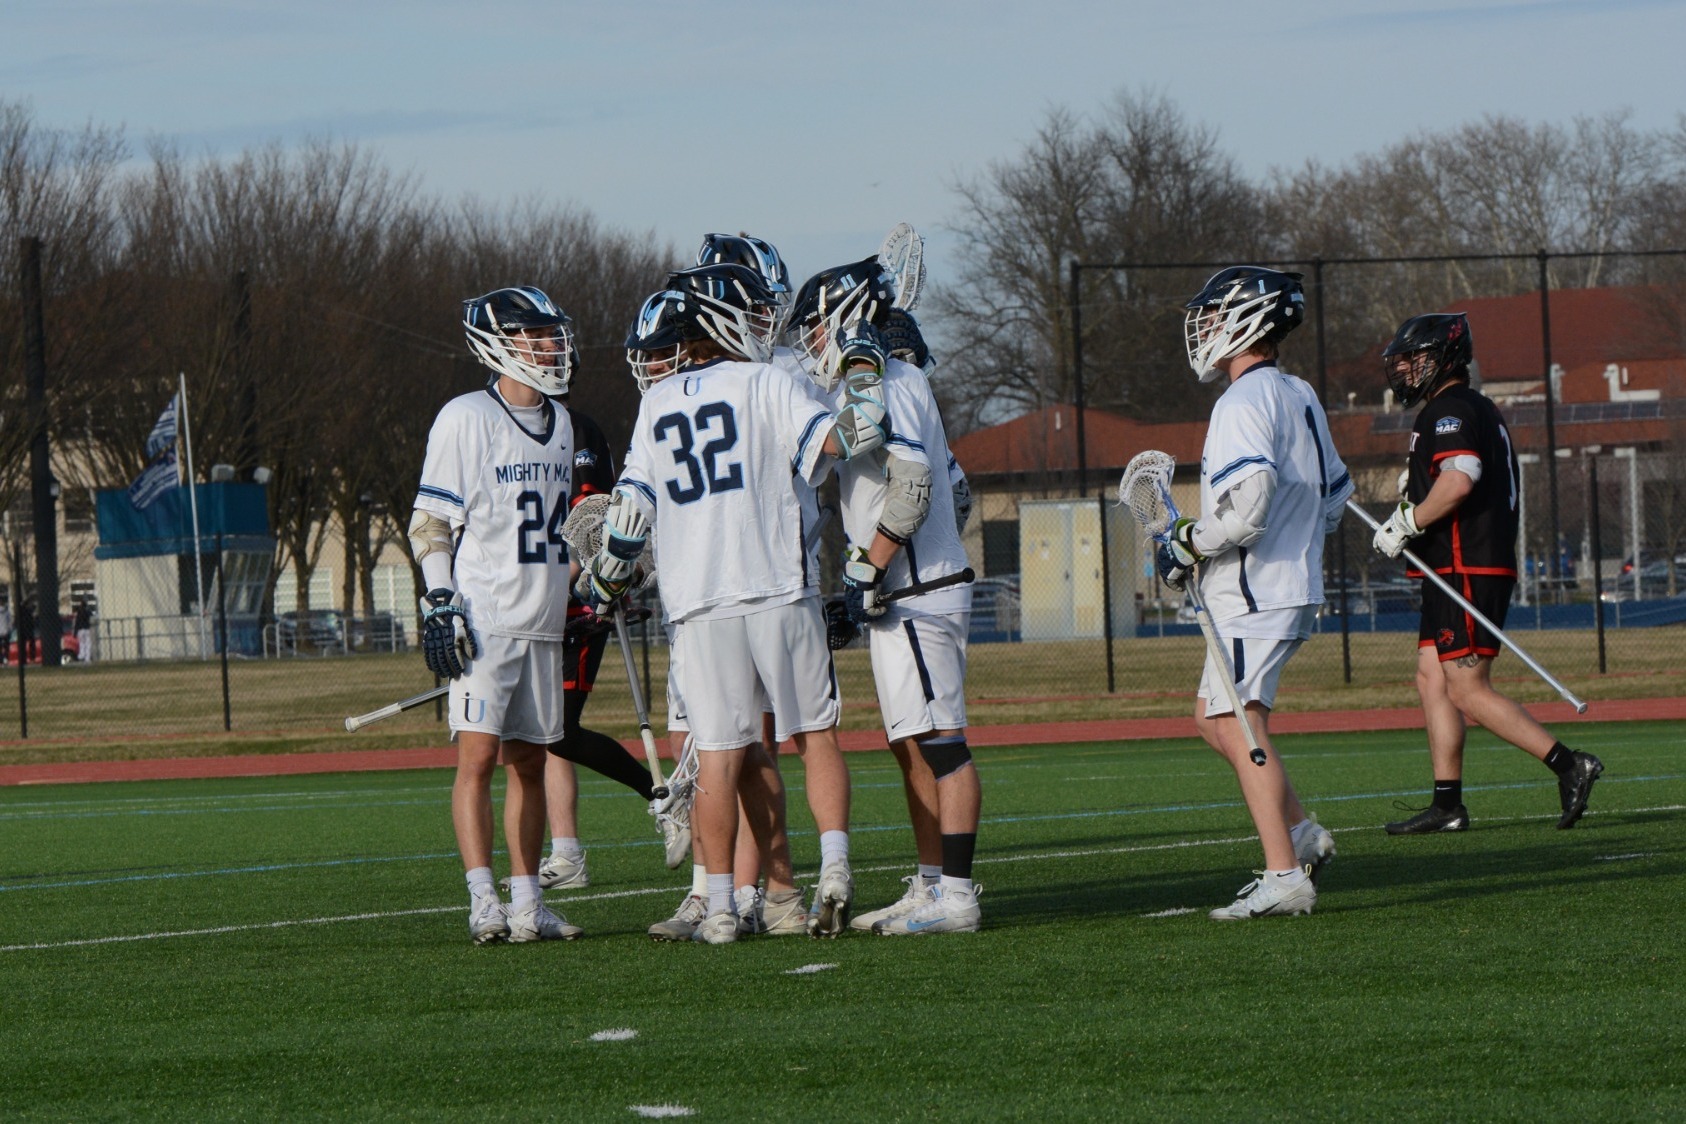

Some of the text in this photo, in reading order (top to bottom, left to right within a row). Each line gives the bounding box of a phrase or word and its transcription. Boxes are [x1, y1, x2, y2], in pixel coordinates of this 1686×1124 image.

[653, 400, 745, 506] 32
[1304, 405, 1327, 498] 1
[1435, 424, 1459, 434] MAC
[495, 462, 551, 484] MIGHTY
[516, 490, 570, 564] 24
